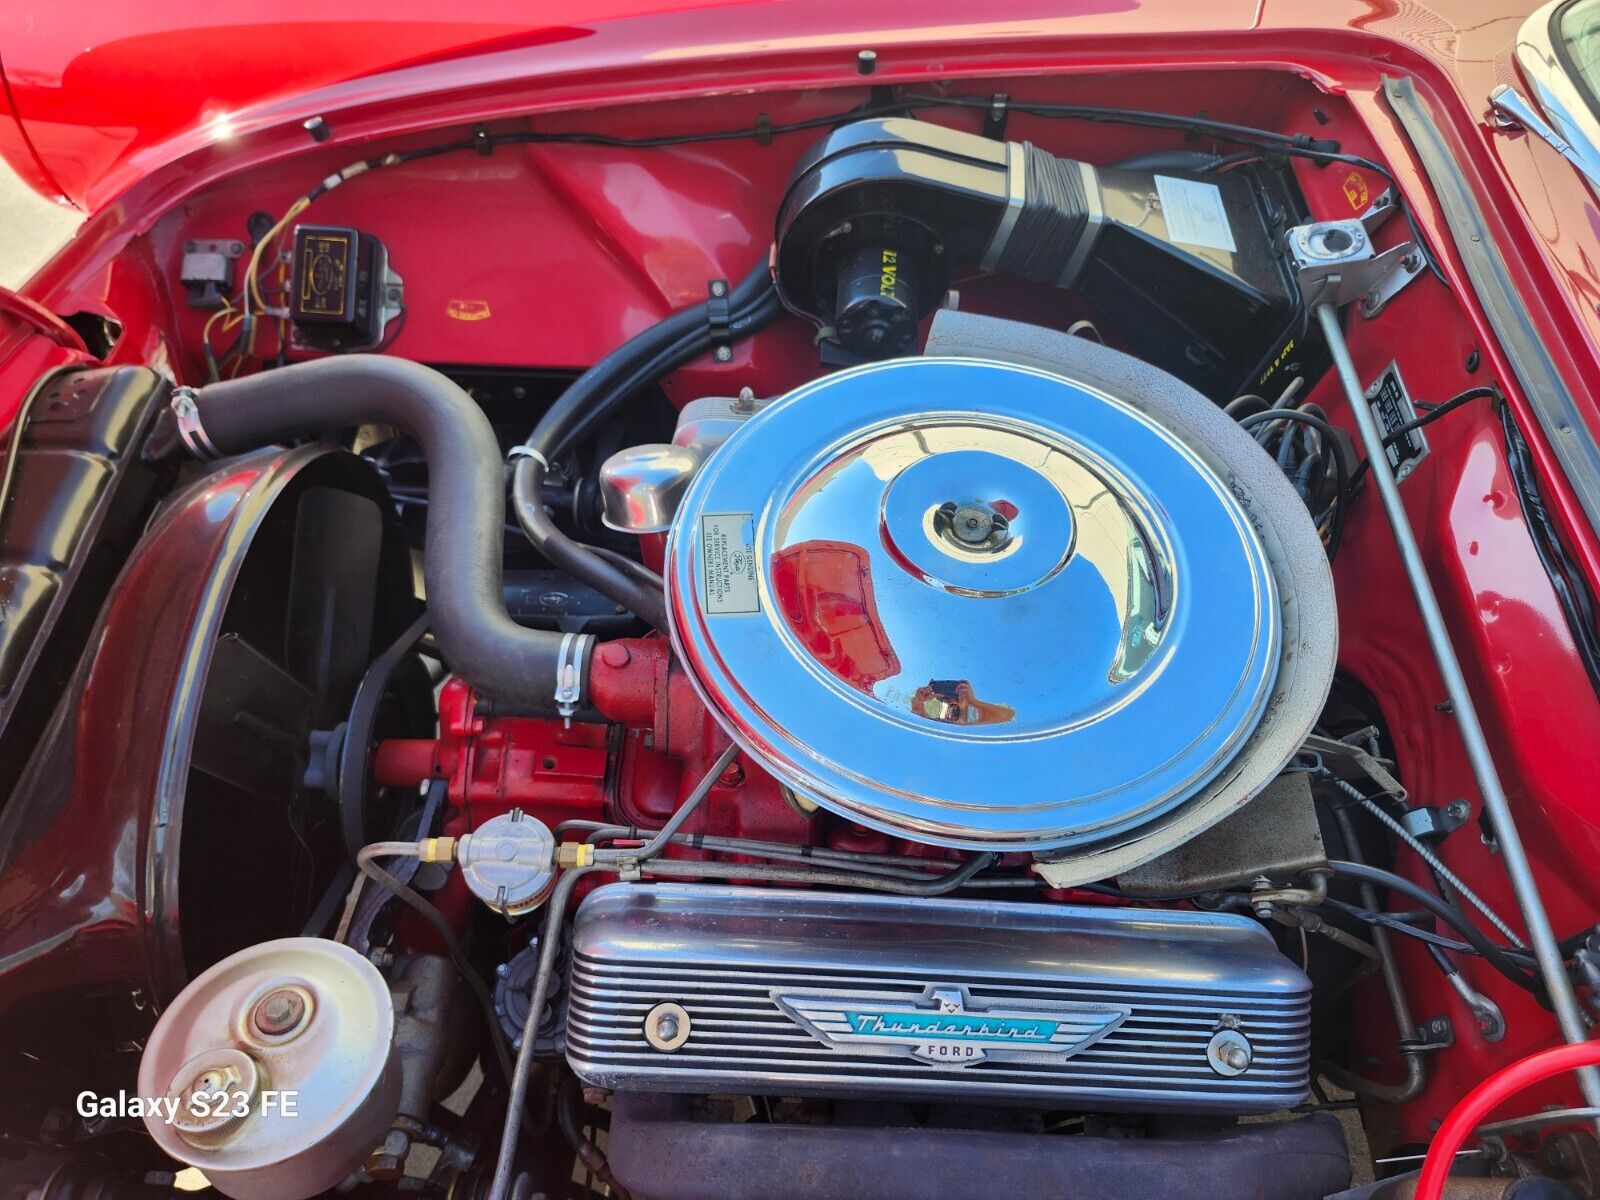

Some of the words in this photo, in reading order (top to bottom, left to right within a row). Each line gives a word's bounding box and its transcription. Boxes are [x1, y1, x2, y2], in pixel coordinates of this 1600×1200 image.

[882, 251, 897, 264] 12
[713, 538, 721, 560] SERVICE
[721, 533, 730, 572] REPLACEMENT
[746, 556, 755, 581] GENUINE
[708, 569, 716, 595] MANUAL
[715, 563, 724, 603] INSTRUCTIONS
[723, 574, 731, 593] PARTS
[857, 1014, 1046, 1039] Thunderbird
[928, 1045, 974, 1057] FORD
